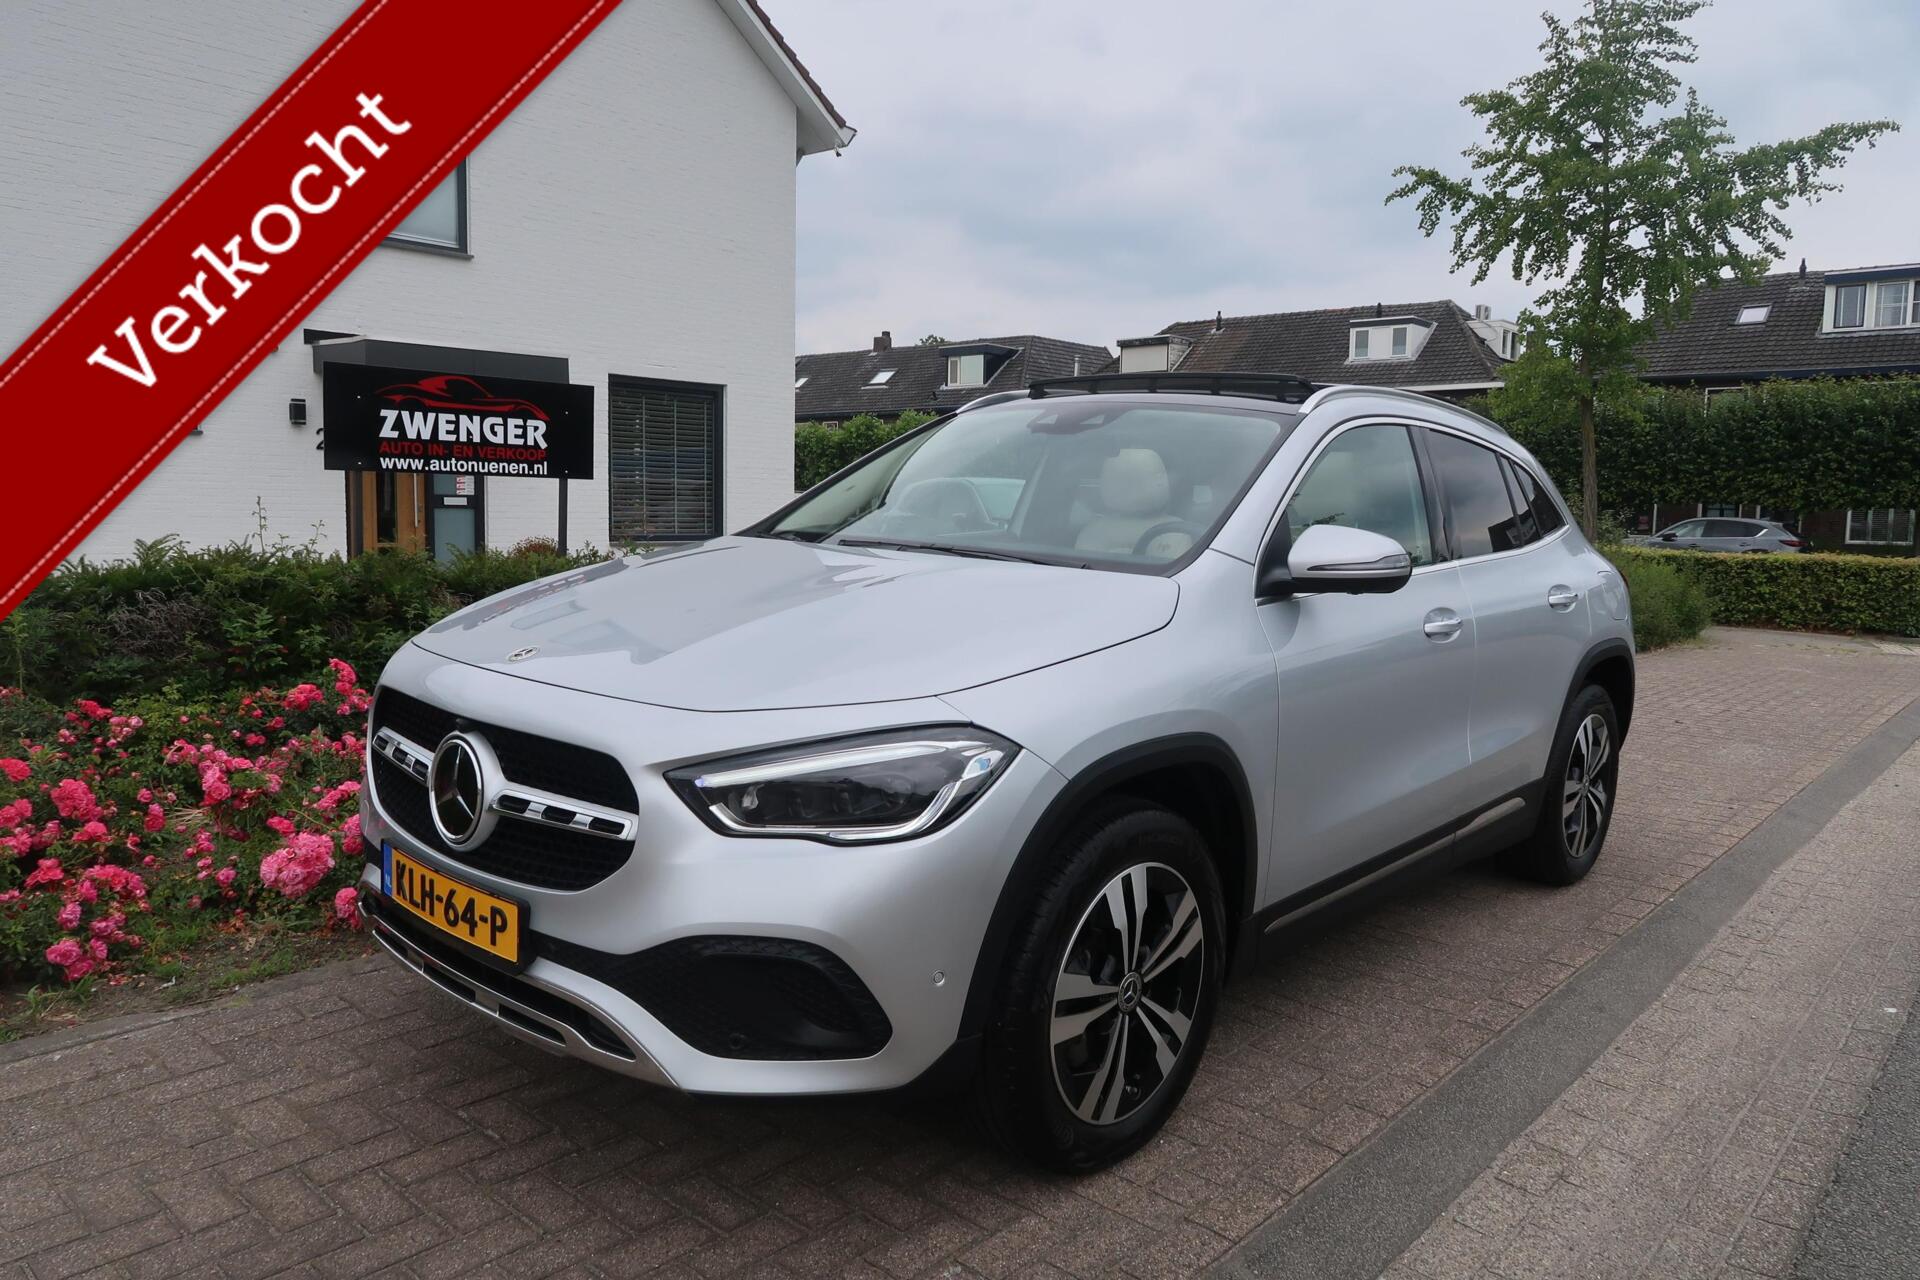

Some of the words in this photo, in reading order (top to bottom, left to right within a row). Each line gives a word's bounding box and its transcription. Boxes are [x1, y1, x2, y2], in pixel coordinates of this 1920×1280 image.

[378, 408, 548, 450] ZWENGER
[379, 440, 423, 455] AUTO
[428, 443, 449, 456] IN-
[452, 444, 473, 457] EN
[477, 445, 547, 461] VERKOOP
[379, 456, 548, 475] www.autonuenen.nl
[395, 859, 508, 946] KLH-64-P
